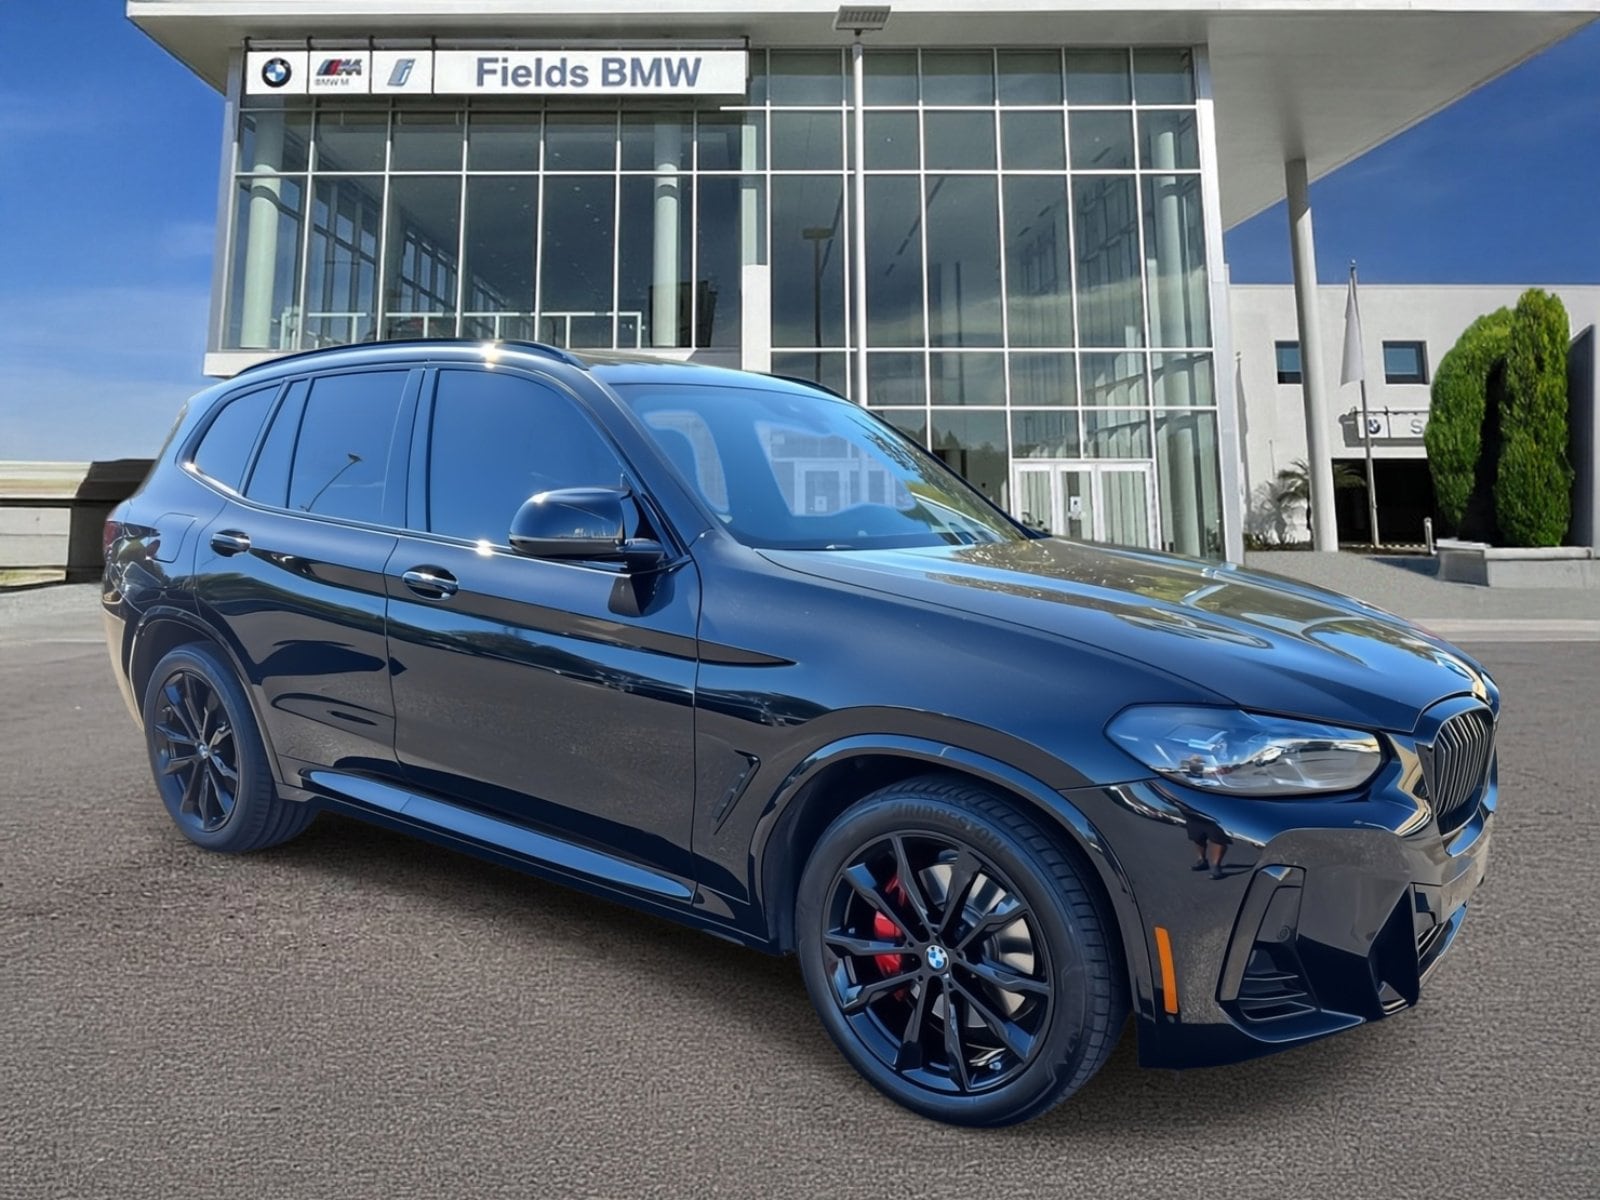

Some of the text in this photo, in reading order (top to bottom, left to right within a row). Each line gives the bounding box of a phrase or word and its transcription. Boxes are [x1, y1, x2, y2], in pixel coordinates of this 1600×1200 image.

[476, 56, 702, 88] Fields BMW
[1410, 418, 1424, 435] S
